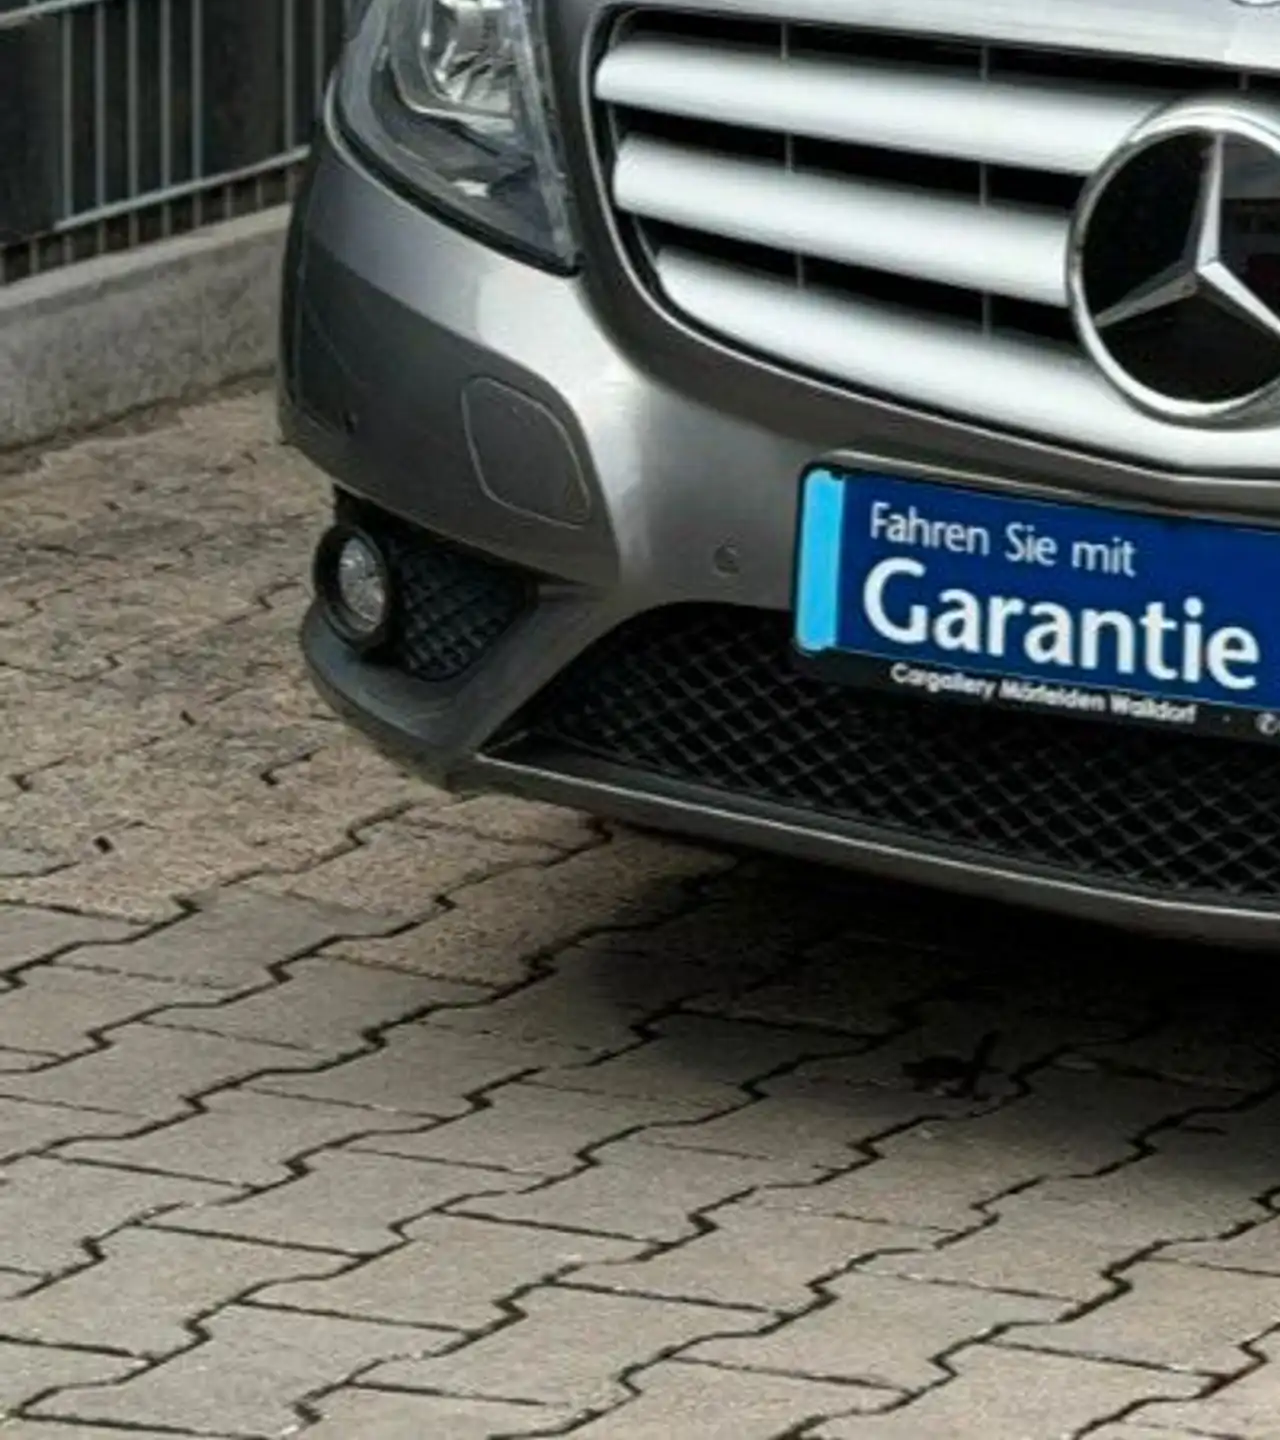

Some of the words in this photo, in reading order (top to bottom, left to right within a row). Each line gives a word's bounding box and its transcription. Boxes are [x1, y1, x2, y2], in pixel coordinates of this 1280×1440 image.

[869, 501, 990, 558] Fahren
[1004, 521, 1058, 567] Sie
[1071, 536, 1138, 578] mit
[862, 556, 1261, 690] Garantie
